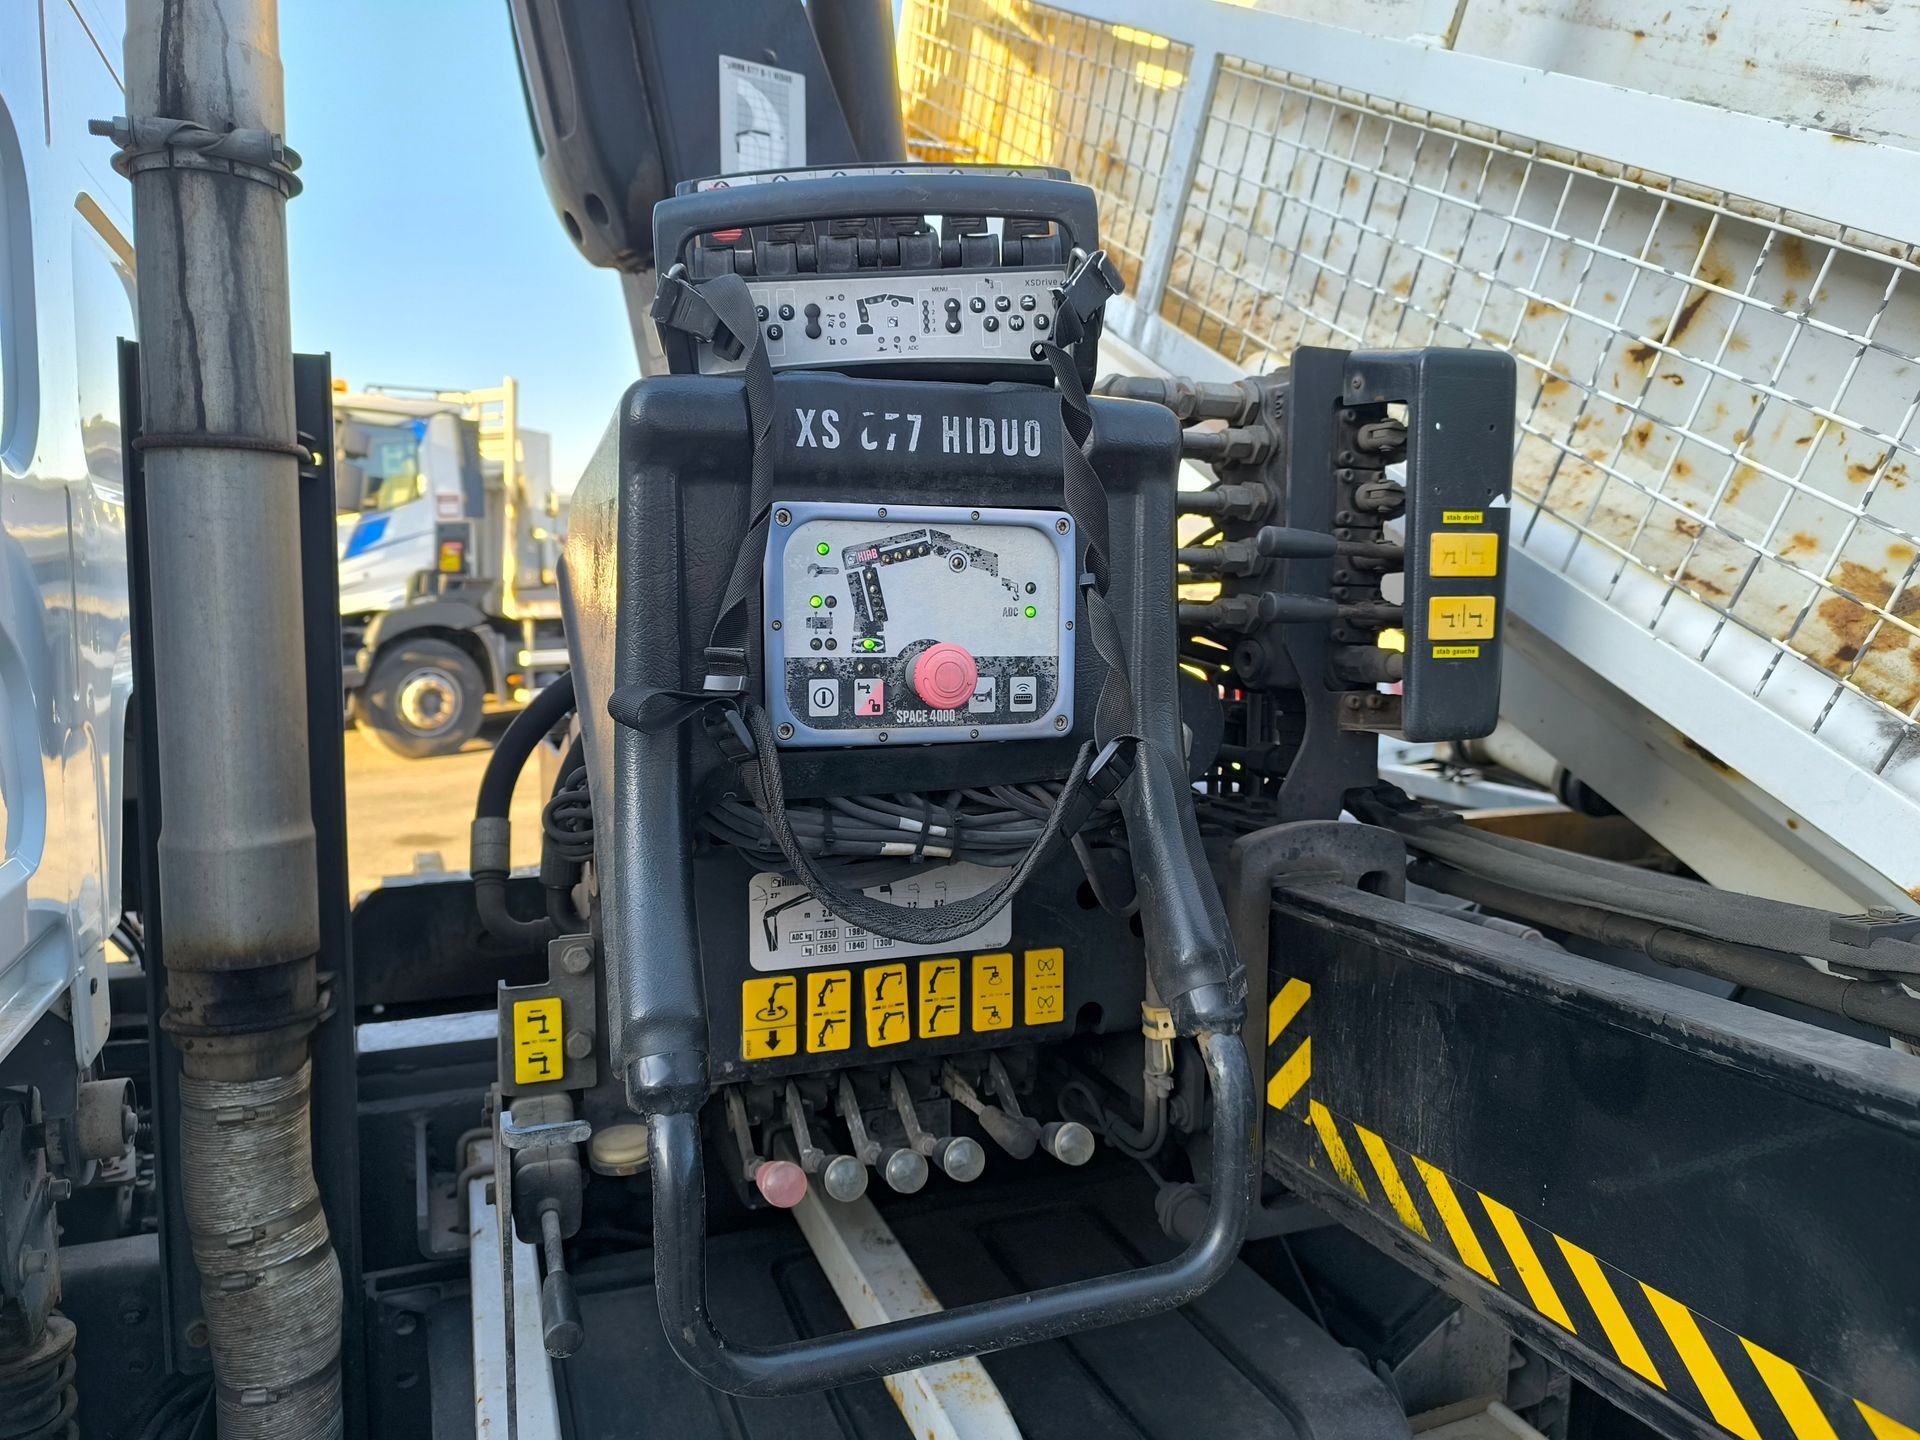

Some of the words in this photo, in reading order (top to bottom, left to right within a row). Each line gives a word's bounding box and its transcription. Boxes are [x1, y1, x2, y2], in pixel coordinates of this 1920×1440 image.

[1024, 278, 1058, 287] XSDrive
[757, 308, 764, 317] 2
[782, 307, 790, 316] 3
[988, 319, 994, 327] 7
[1038, 317, 1044, 325] 8
[771, 327, 778, 336] 6
[795, 408, 840, 449] XS
[942, 415, 1041, 457] HIDUO
[857, 548, 878, 562] HIAB
[1002, 606, 1019, 617] ADC
[896, 709, 928, 723] SPACE
[929, 709, 956, 722] 4000
[792, 933, 804, 941] ADC
[805, 932, 812, 941] kg
[819, 930, 837, 938] 2850
[848, 928, 865, 936] 1980
[805, 947, 812, 956] kg
[848, 941, 865, 950] 1840
[876, 939, 893, 947] 1300
